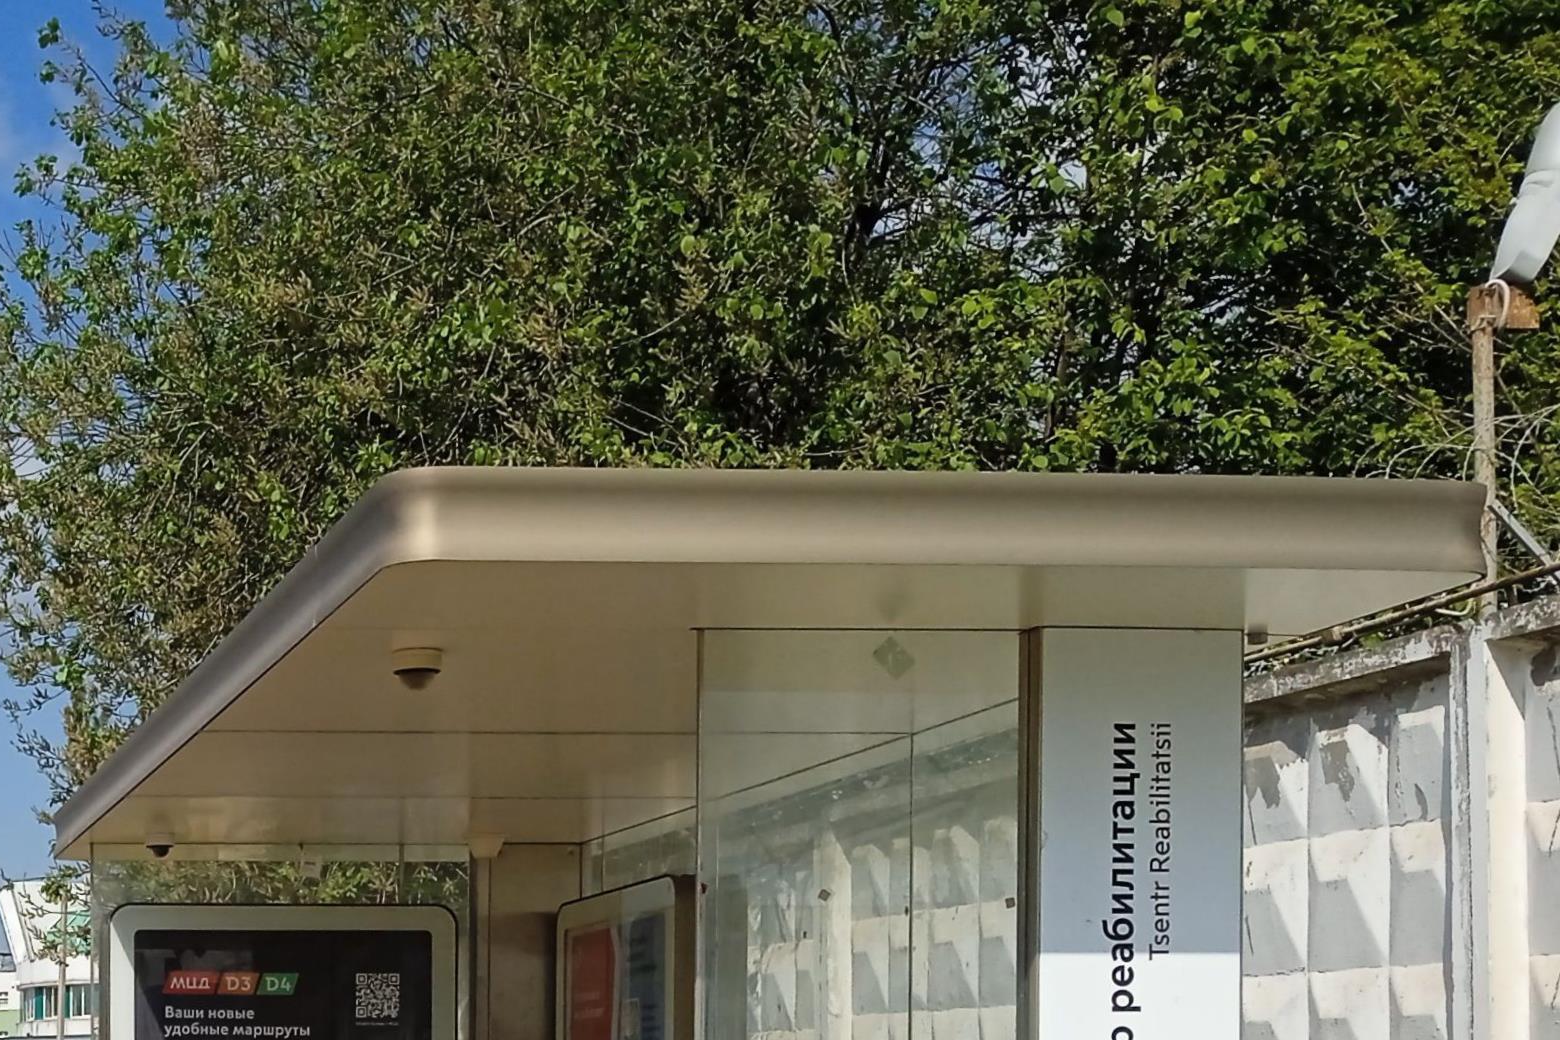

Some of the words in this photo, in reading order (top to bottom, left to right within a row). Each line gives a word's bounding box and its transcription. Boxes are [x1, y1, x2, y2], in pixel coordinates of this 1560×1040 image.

[1149, 722, 1173, 874] Reabilitatsii
[1102, 722, 1141, 1013] реабилитации
[1149, 881, 1172, 961] Tsentr
[170, 976, 210, 989] МЦД
[225, 976, 251, 991] D3
[265, 976, 291, 992] D4
[164, 1005, 205, 1019] Ваши
[208, 1008, 255, 1019] новые
[164, 1022, 229, 1038] удобные
[232, 1025, 311, 1038] маршруты
